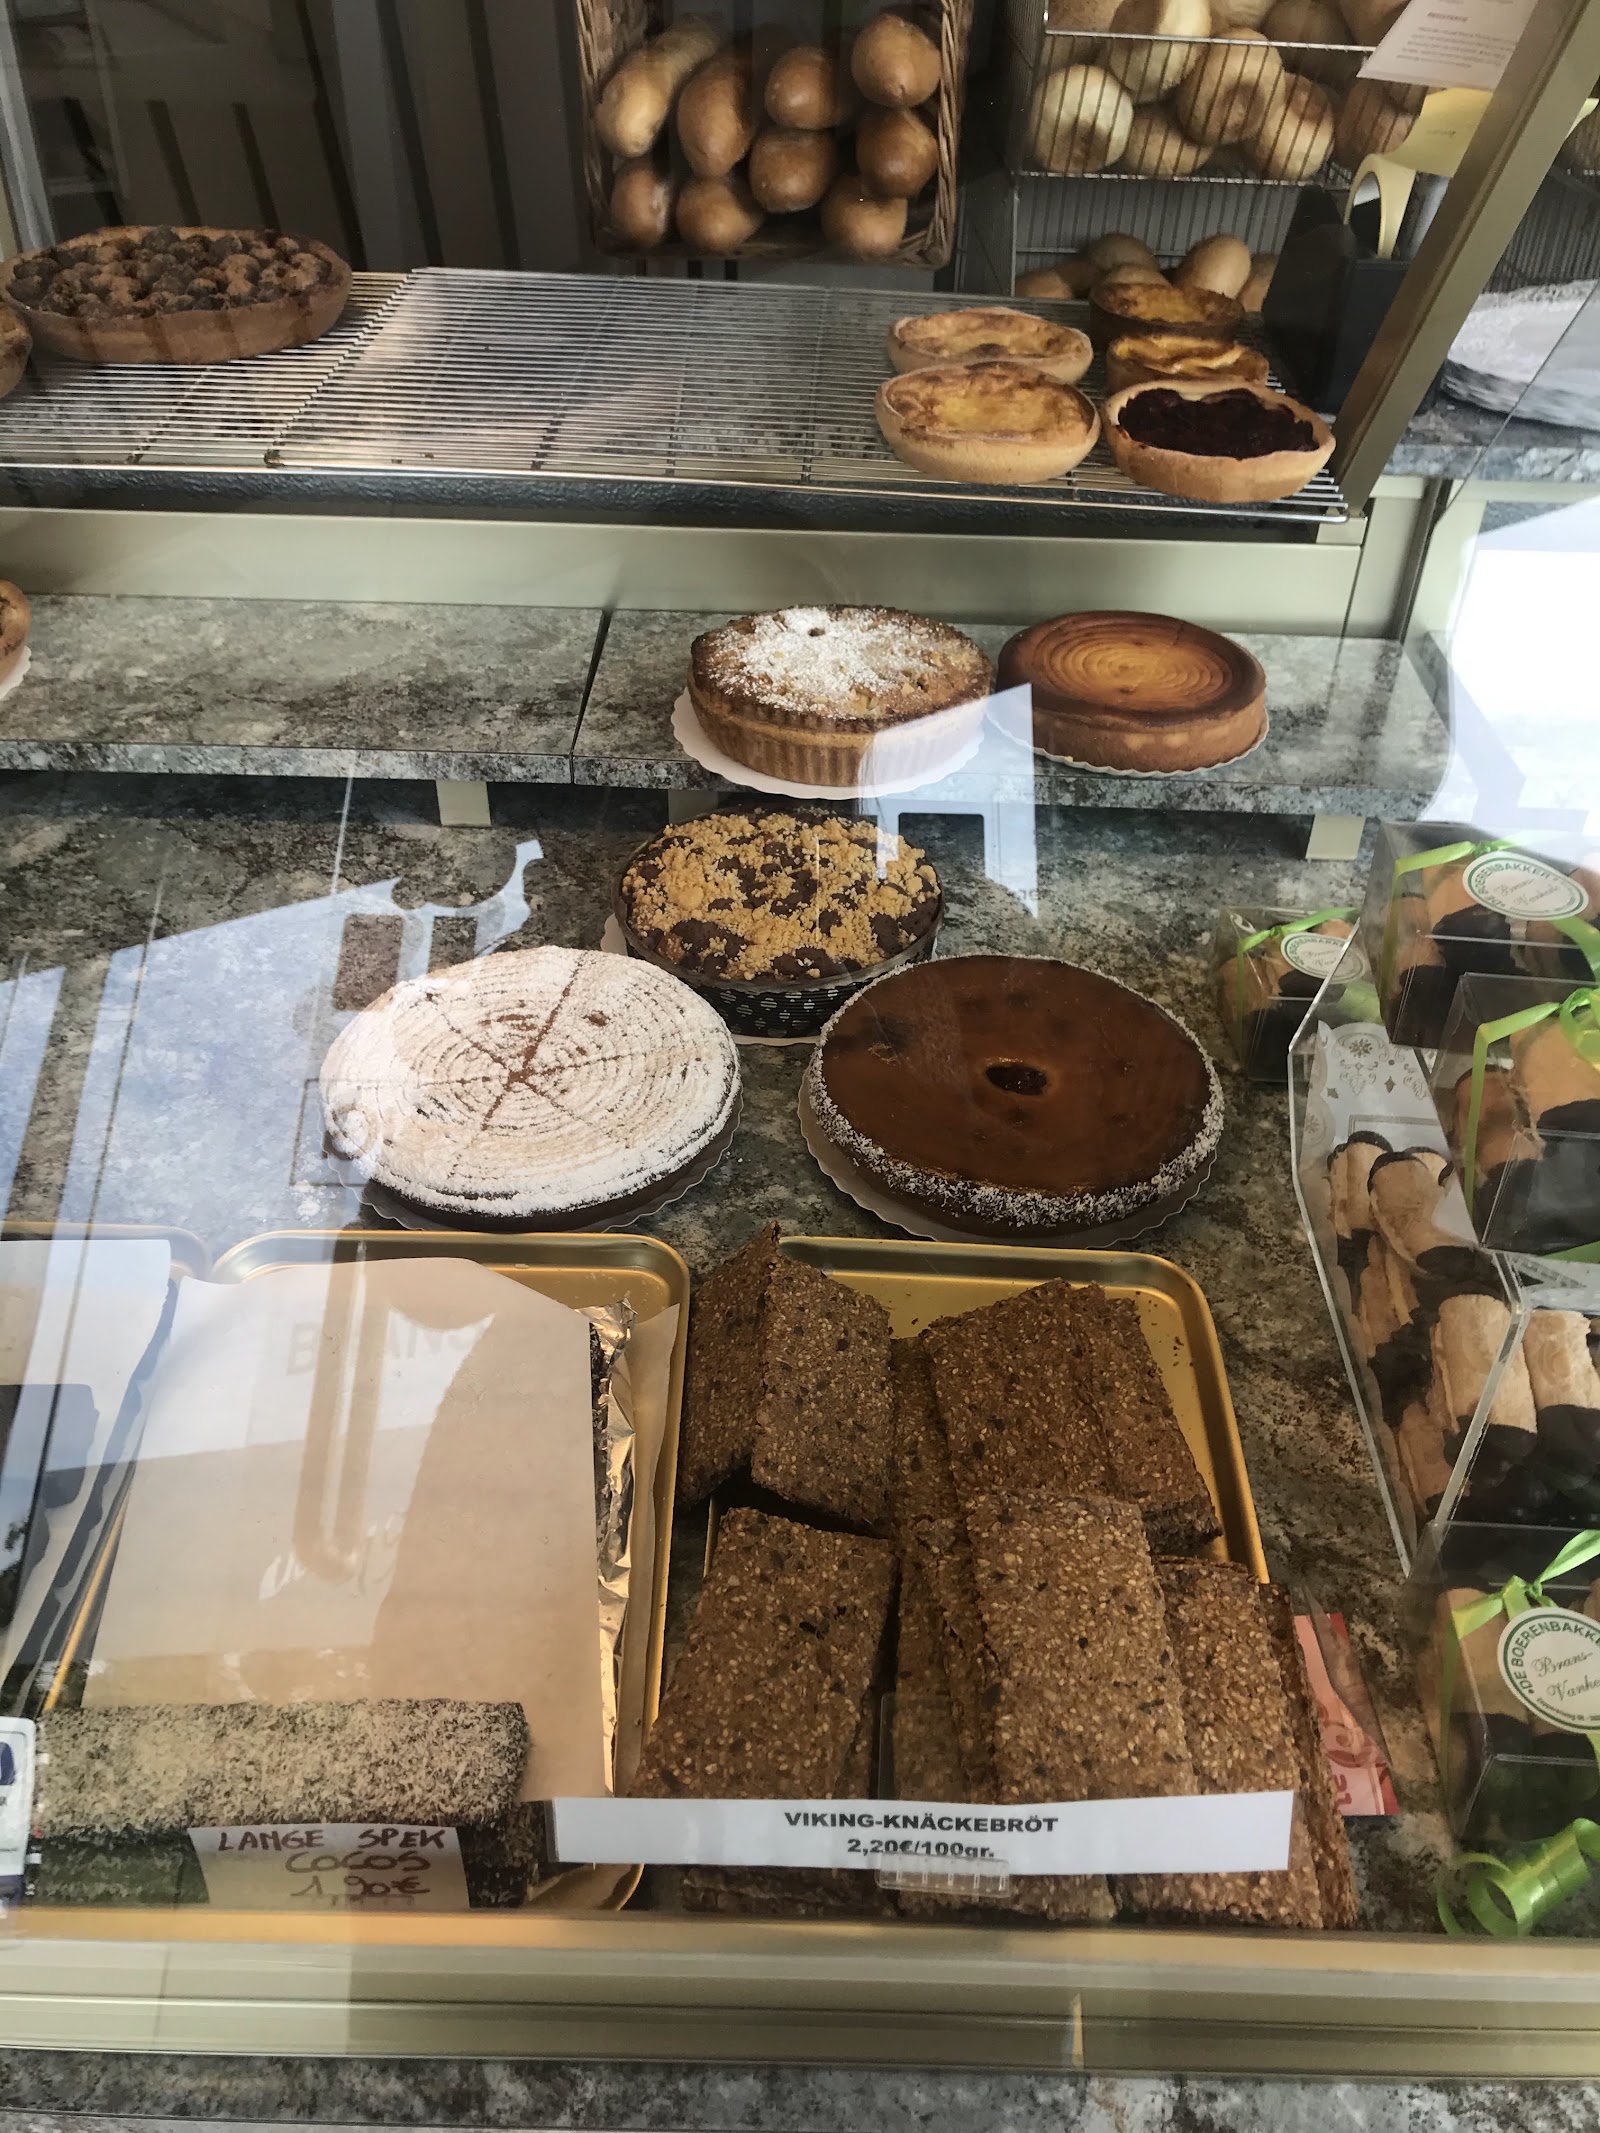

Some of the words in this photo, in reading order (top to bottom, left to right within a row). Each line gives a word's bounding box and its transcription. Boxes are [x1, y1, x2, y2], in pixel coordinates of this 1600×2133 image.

[1532, 1651, 1593, 1677] Brans
[1513, 1670, 1533, 1690] DE
[784, 1812, 1059, 1833] VIKING-KNÄCKEBRÖT
[218, 1829, 325, 1851] LANGE
[358, 1828, 446, 1850] SPEK
[285, 1851, 431, 1873] COCOS
